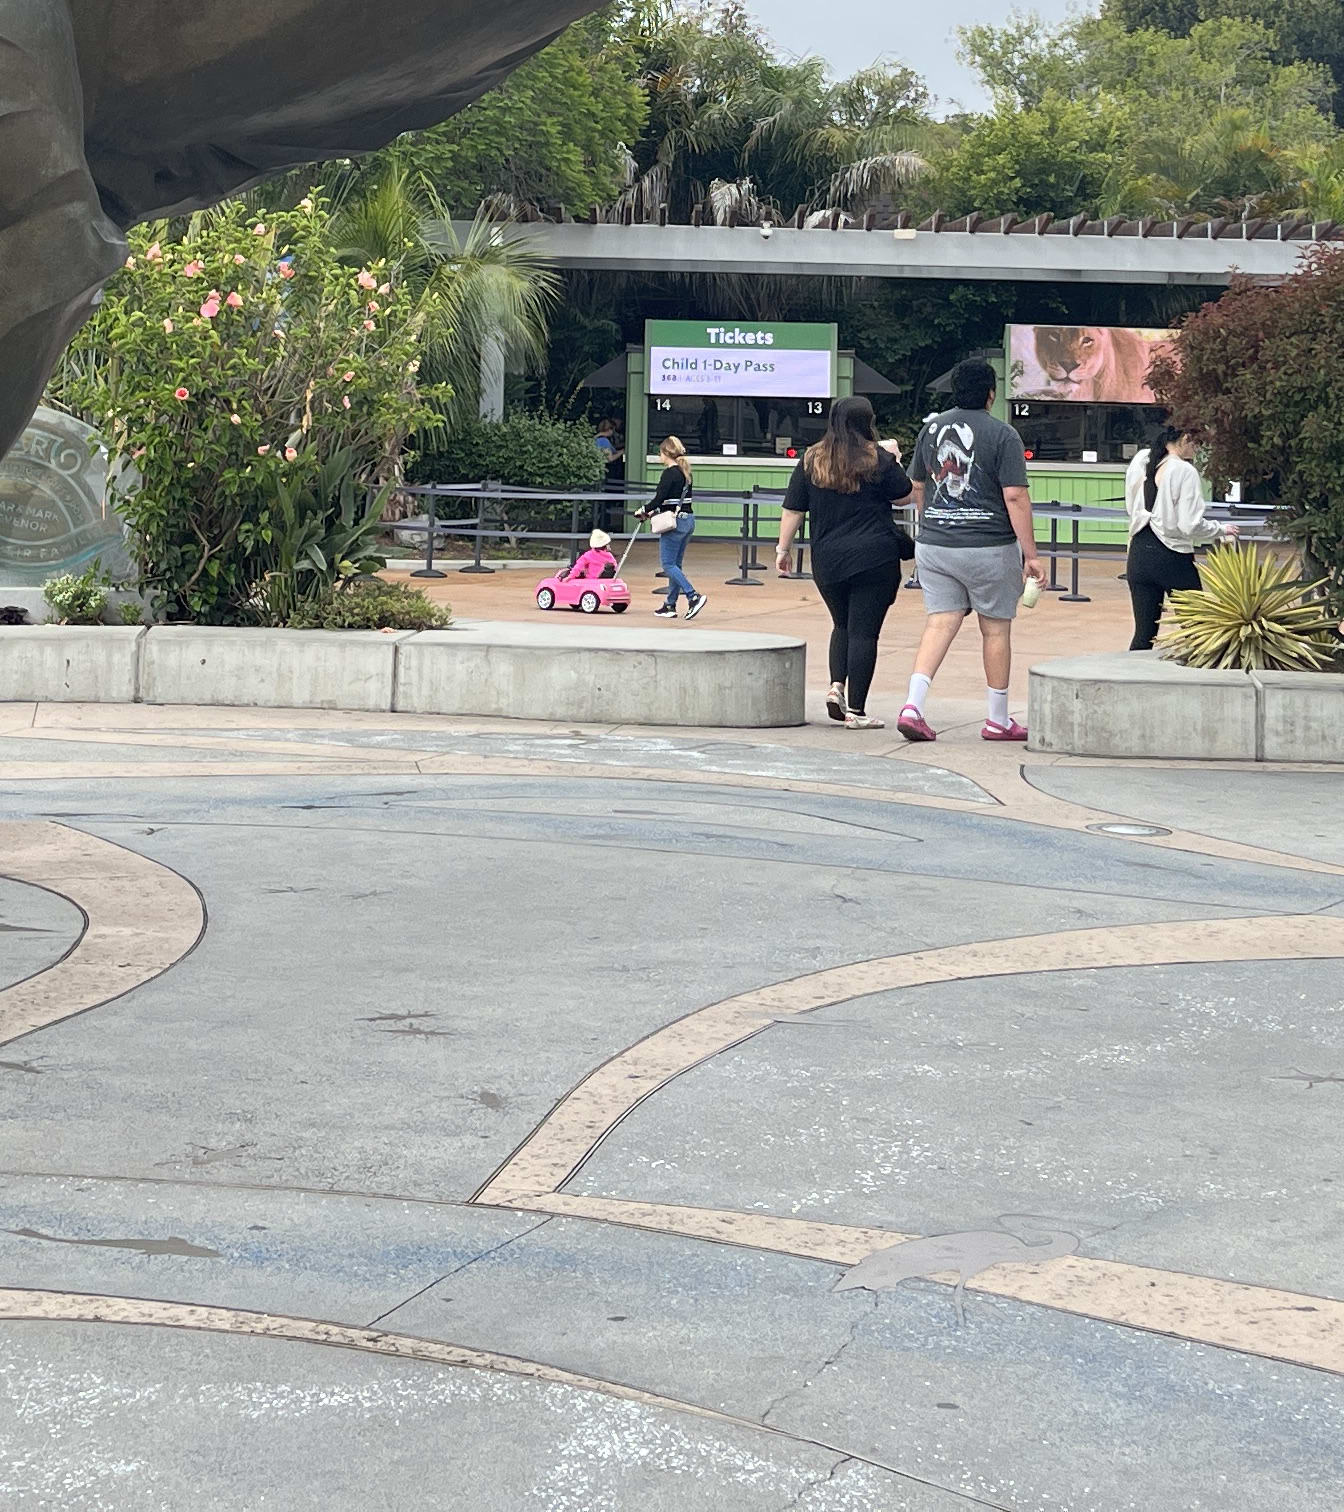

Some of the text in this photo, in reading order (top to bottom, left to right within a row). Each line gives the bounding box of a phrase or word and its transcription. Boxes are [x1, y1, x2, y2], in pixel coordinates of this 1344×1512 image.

[706, 327, 774, 345] Tickets
[661, 357, 775, 375] Child 1-Day Pass
[655, 398, 672, 411] 14
[807, 401, 823, 414] 13
[1013, 403, 1030, 416] 12
